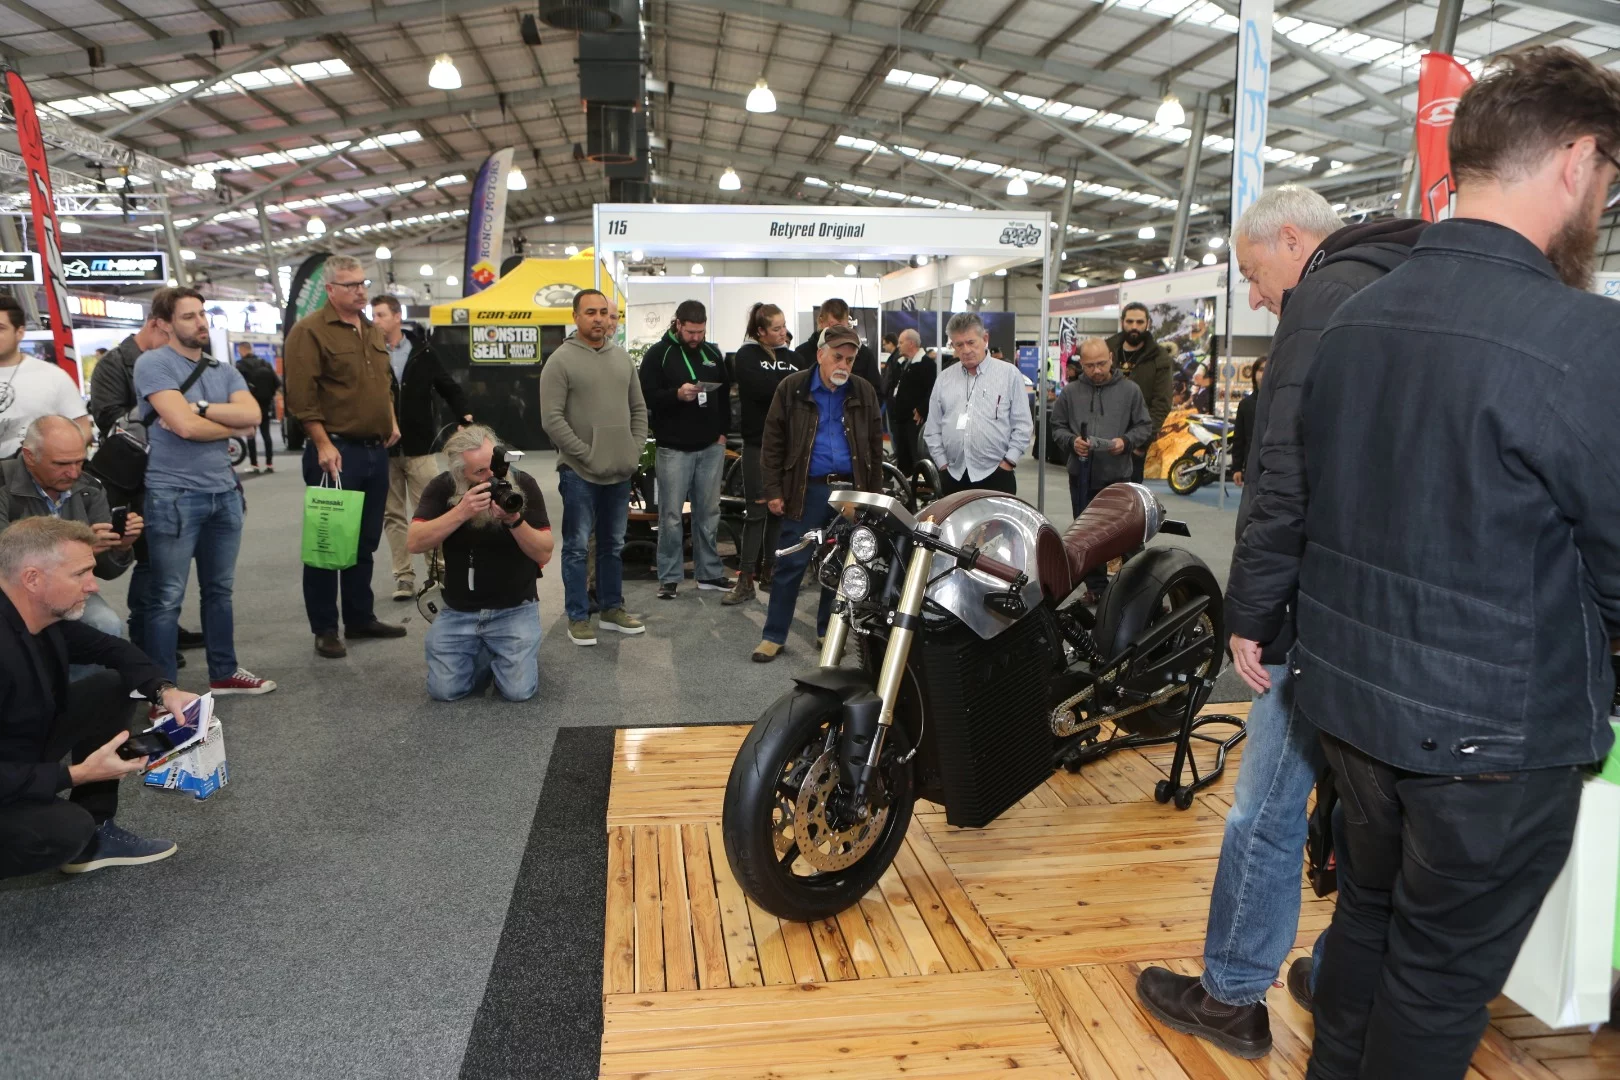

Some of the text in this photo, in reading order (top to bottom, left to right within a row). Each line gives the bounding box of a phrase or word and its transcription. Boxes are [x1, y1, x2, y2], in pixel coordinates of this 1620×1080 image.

[481, 160, 501, 258] RONCO MOTORS
[608, 220, 628, 235] 115
[769, 221, 865, 240] Retyred Original
[476, 310, 533, 320] can-am
[473, 326, 538, 343] MONSTER
[473, 344, 507, 359] SEAL
[312, 498, 344, 506] Kawasaki
